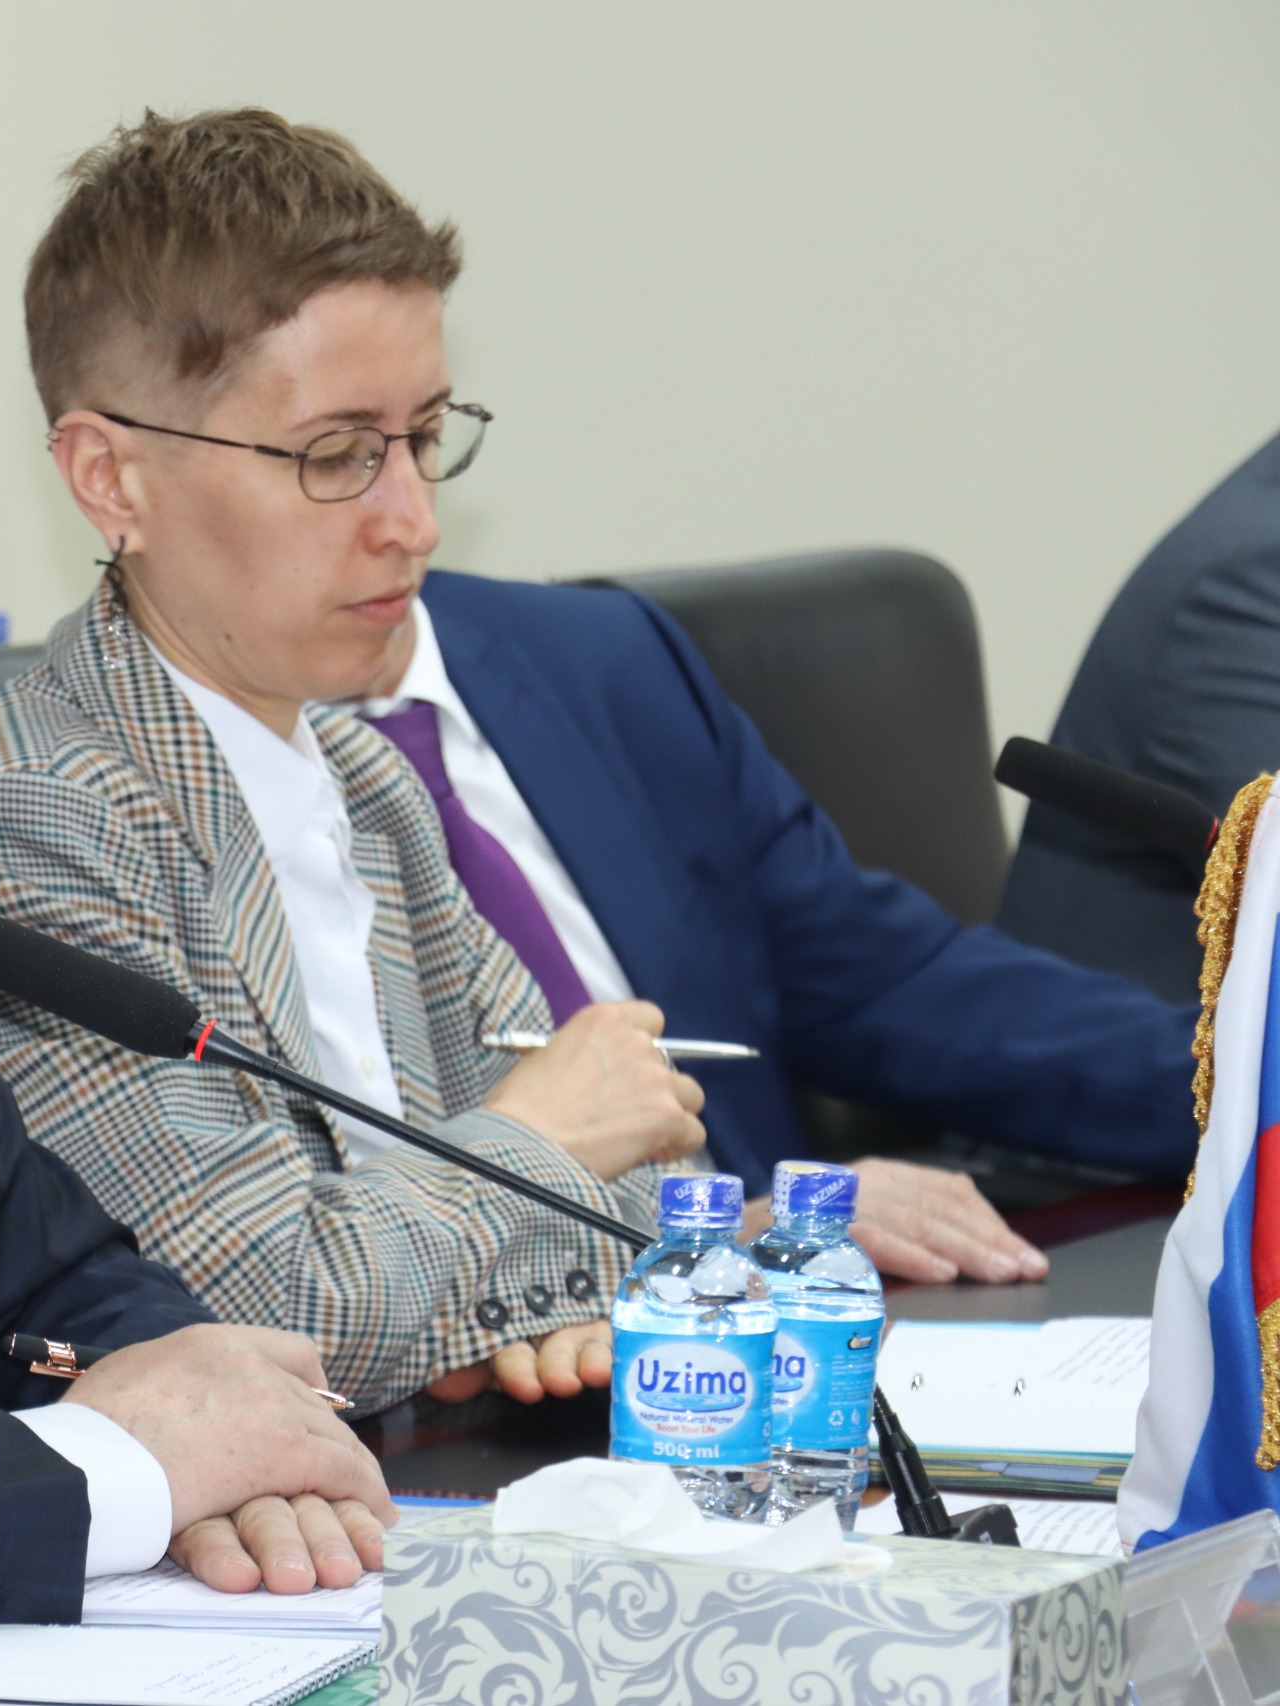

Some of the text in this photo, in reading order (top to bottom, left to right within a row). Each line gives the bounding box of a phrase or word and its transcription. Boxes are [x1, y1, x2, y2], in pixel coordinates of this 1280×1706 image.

[809, 1178, 847, 1206] UZIMA
[638, 1358, 746, 1394] Uzima
[640, 1411, 669, 1422] Natural
[709, 1415, 734, 1425] Water
[656, 1423, 717, 1434] Boost Your Life
[653, 1441, 720, 1459] 500 ml
